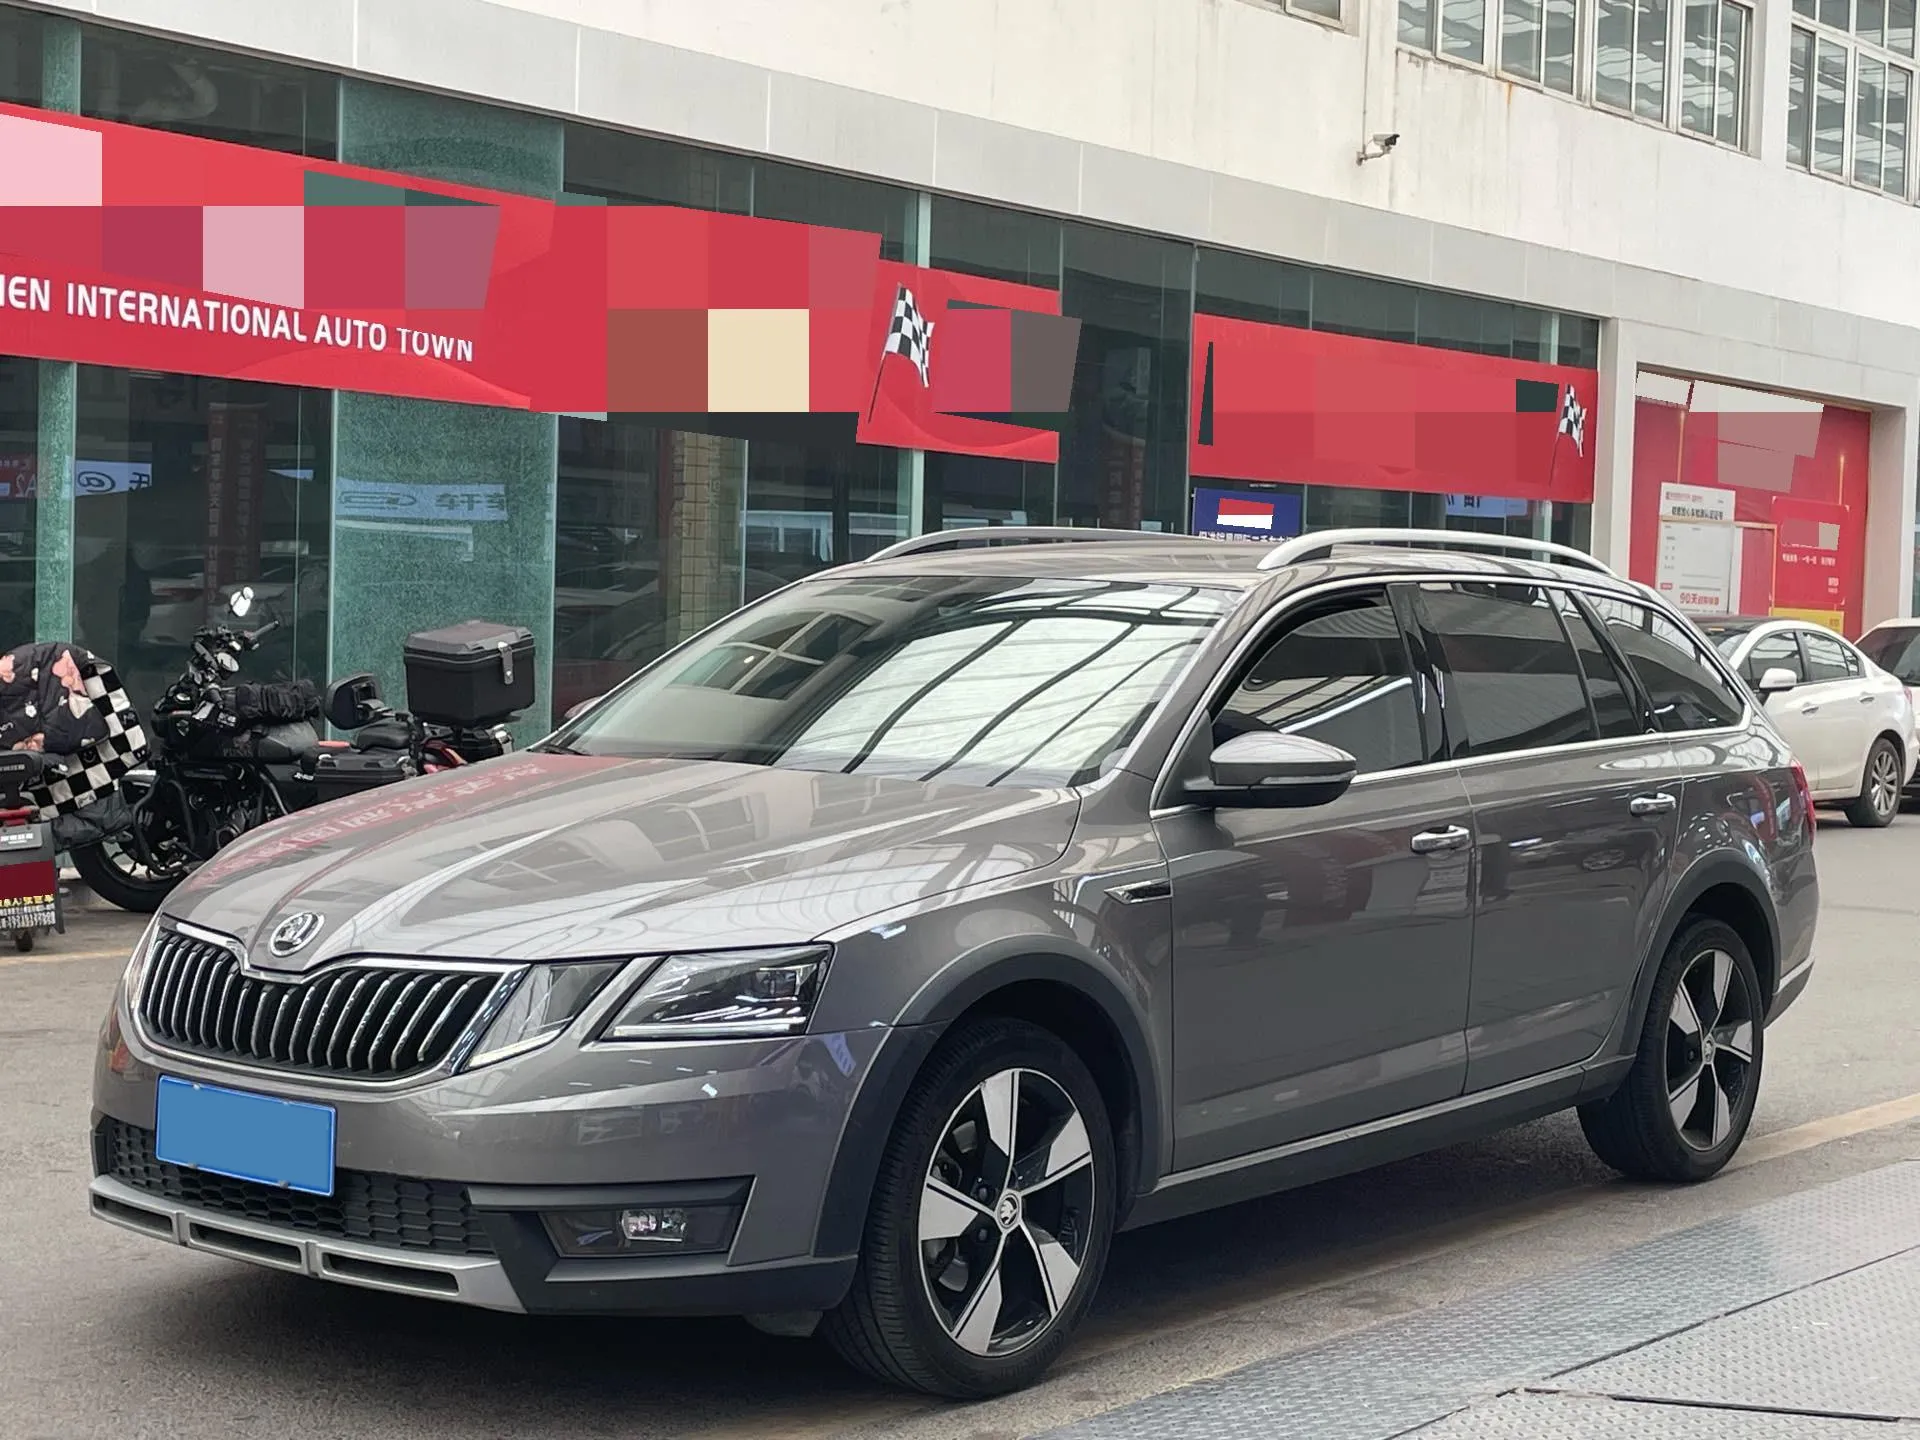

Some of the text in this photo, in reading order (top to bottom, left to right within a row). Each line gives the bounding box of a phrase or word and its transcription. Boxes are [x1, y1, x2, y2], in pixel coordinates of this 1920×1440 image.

[67, 282, 307, 342] INTERNATIONAL
[313, 314, 387, 351] AUTO
[396, 327, 473, 362] TOWN
